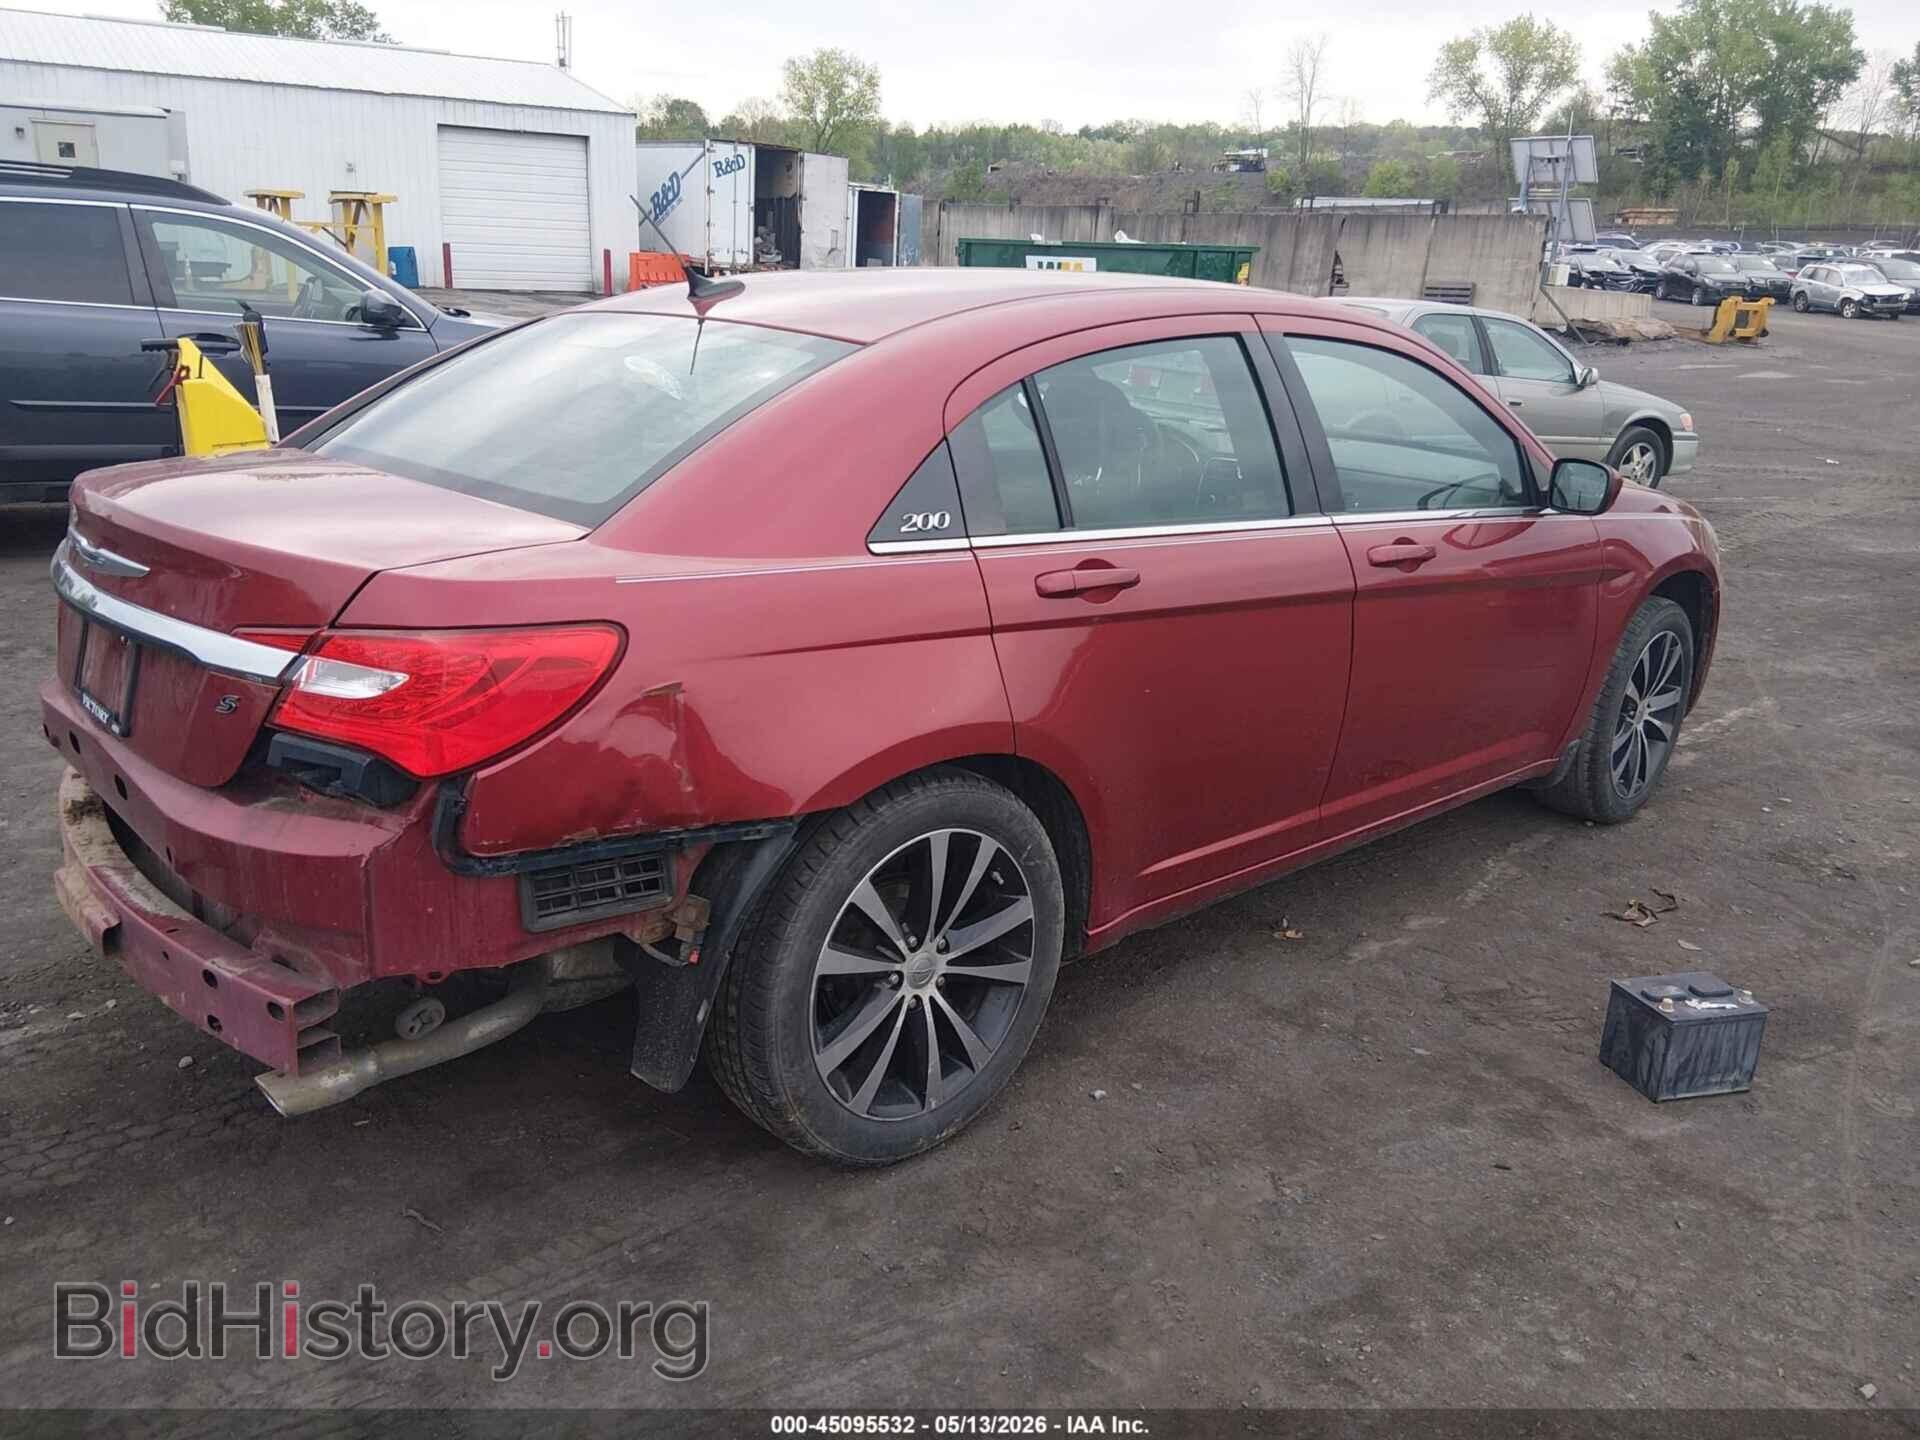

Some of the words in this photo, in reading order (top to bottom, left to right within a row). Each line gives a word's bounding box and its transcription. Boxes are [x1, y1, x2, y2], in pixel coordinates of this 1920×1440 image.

[712, 153, 746, 178] R&D
[650, 171, 681, 221] R&D
[900, 511, 951, 532] 200
[215, 694, 241, 714] S
